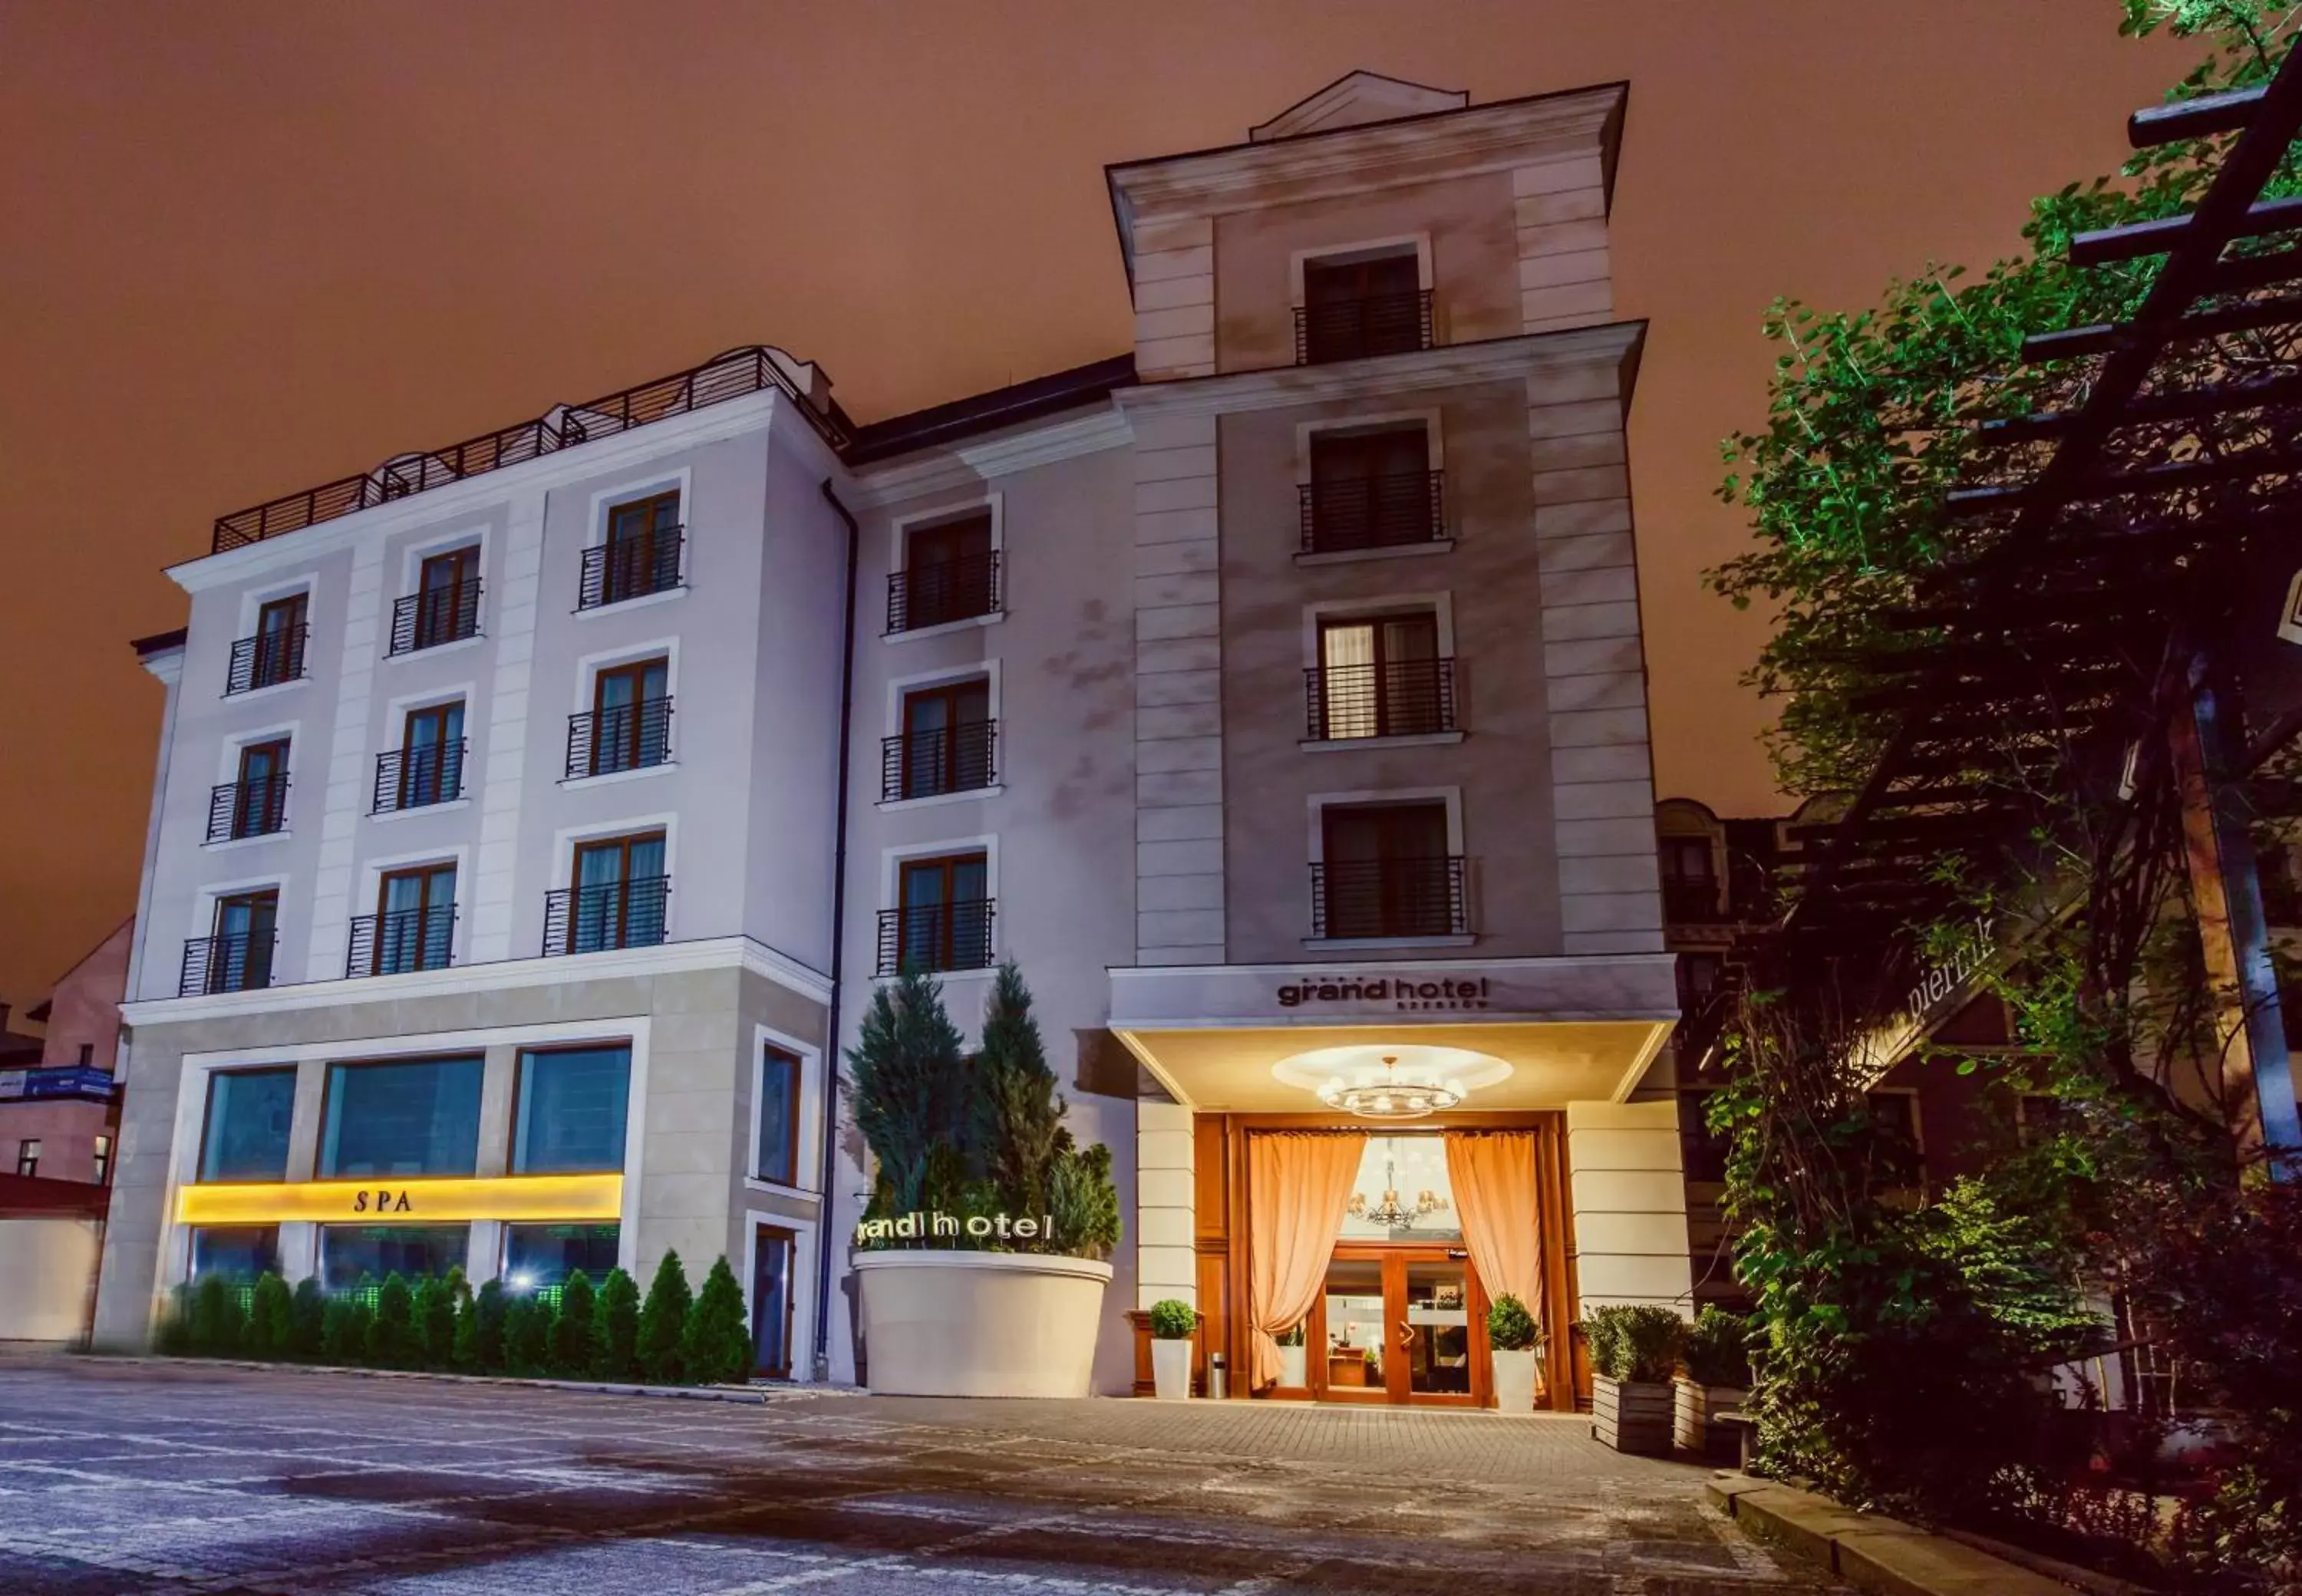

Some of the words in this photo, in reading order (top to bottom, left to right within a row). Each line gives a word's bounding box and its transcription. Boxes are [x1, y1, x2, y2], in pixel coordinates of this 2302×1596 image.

[1278, 979, 1387, 1007] grand
[1395, 977, 1486, 999] hotel
[354, 1190, 412, 1212] SPA
[857, 1212, 925, 1246] rand
[932, 1211, 1053, 1240] hotel
